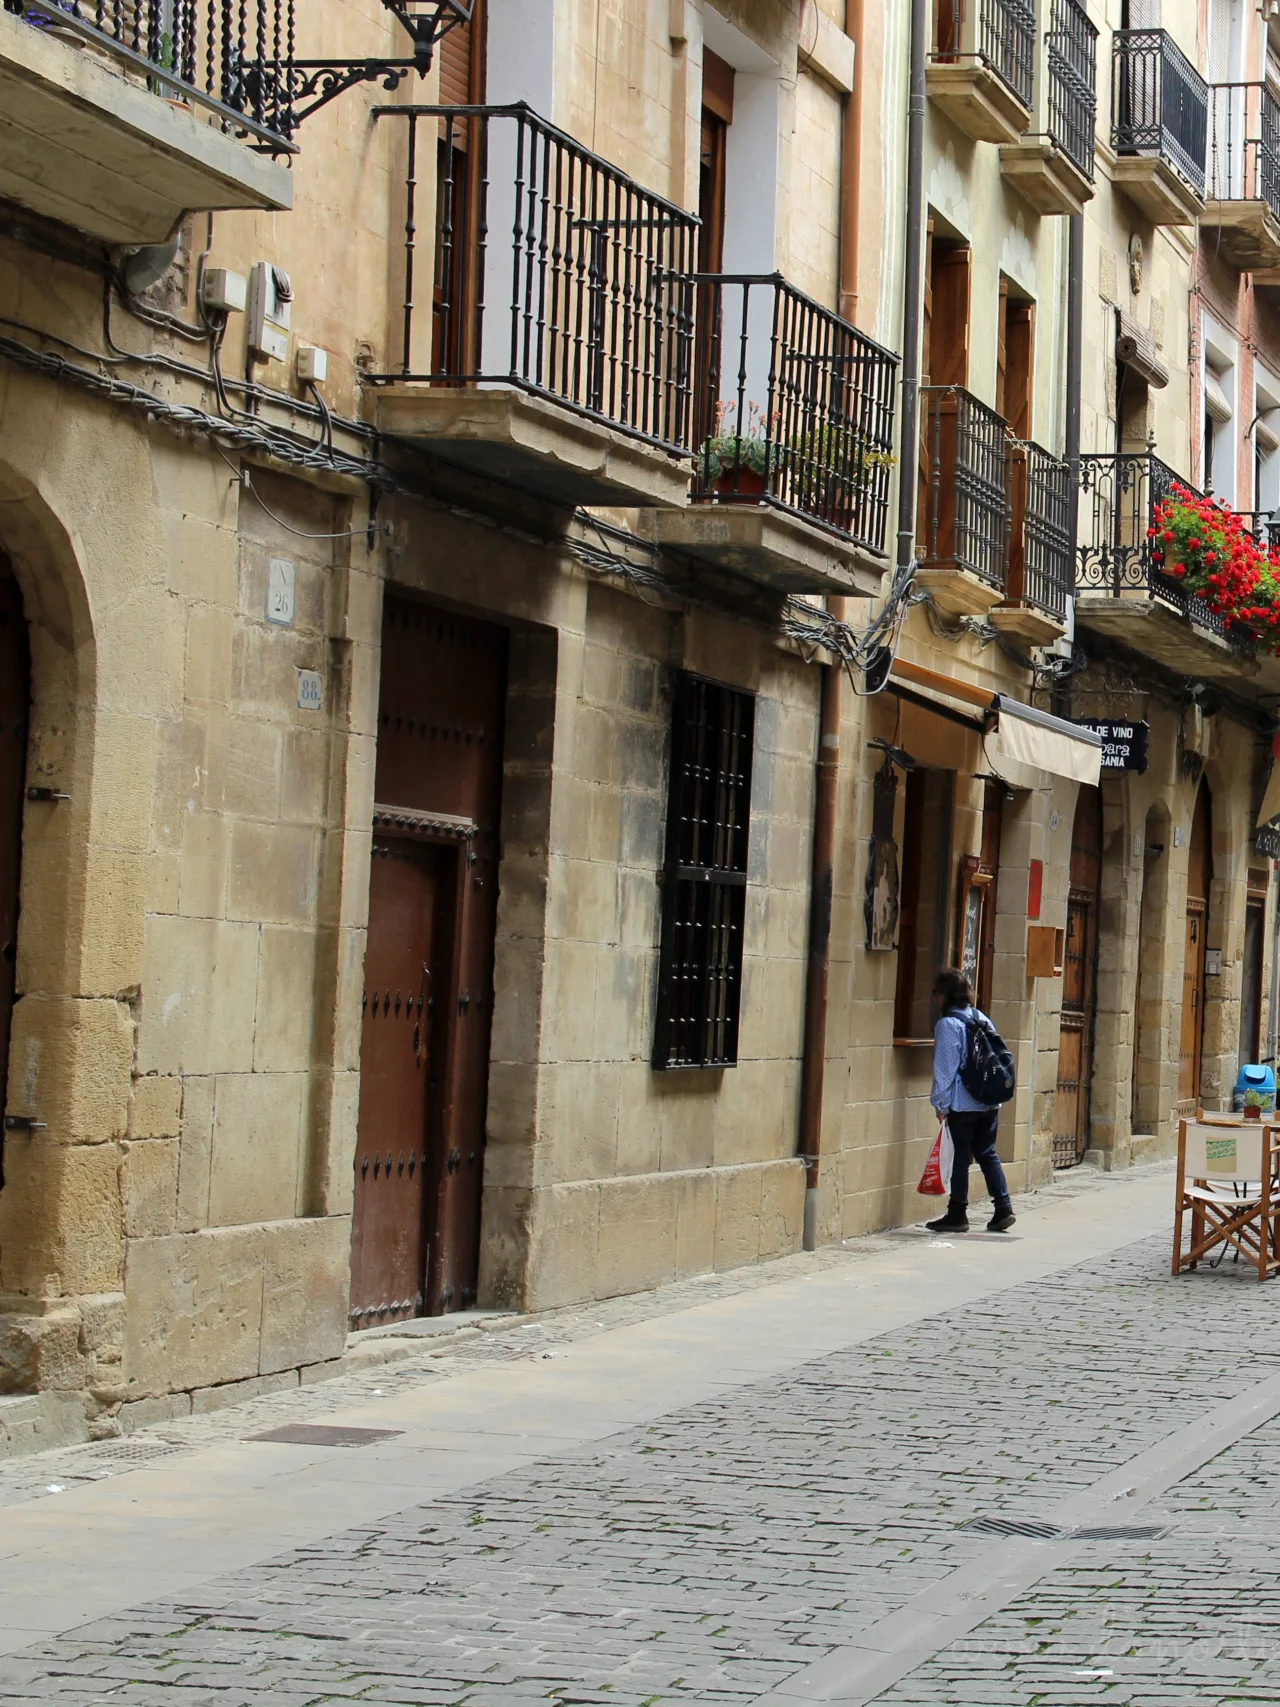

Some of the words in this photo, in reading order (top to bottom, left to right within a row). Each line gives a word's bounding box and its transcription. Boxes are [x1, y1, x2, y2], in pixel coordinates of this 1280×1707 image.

[275, 591, 289, 615] 26
[1096, 726, 1109, 738] DE
[1112, 727, 1134, 739] VINO
